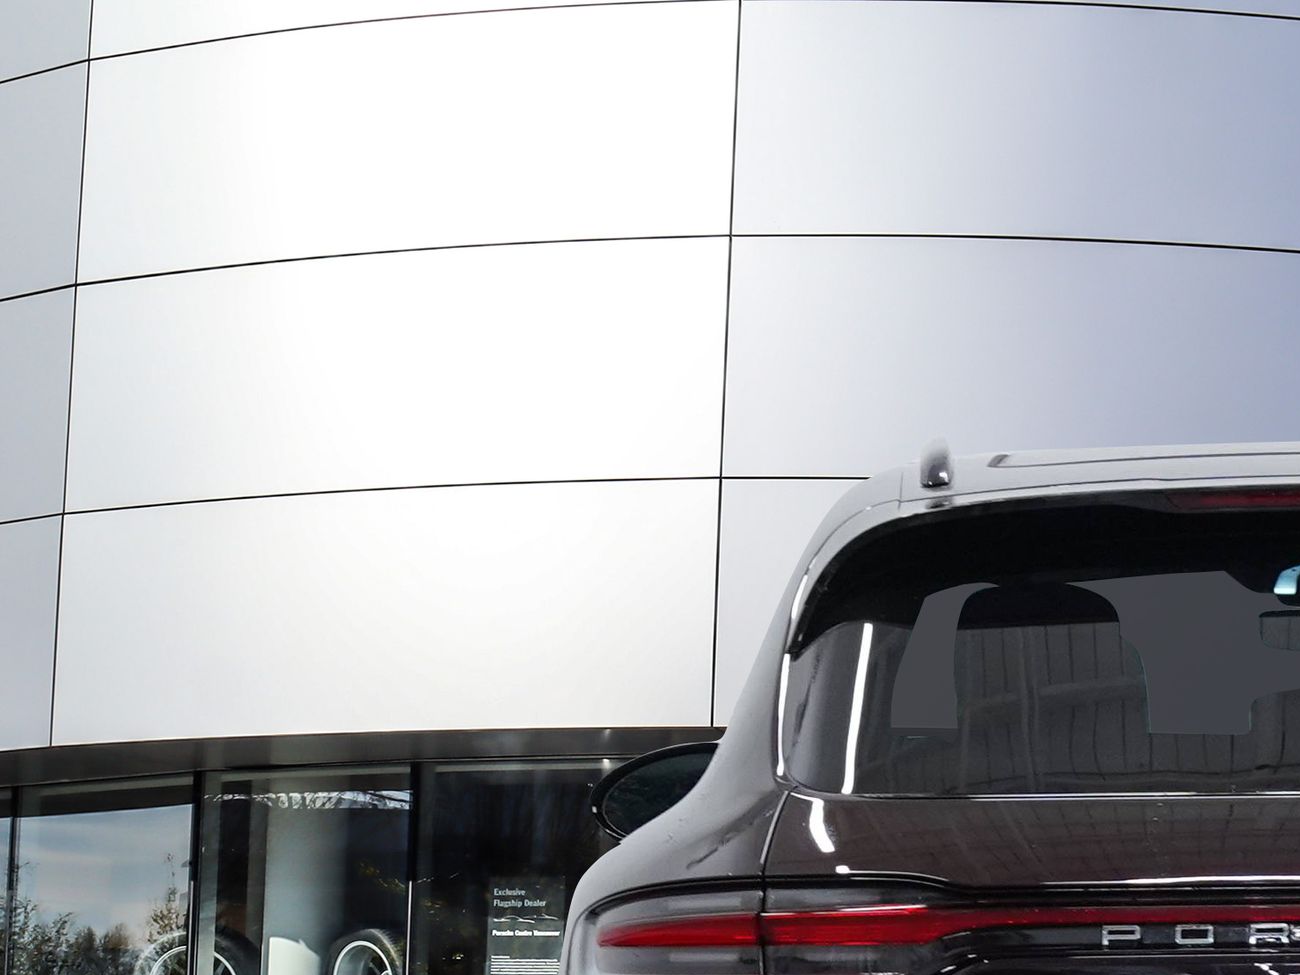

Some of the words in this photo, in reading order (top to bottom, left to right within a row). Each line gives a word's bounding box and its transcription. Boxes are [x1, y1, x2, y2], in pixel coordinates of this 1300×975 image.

[493, 888, 526, 896] Exclusive
[493, 899, 523, 908] Flagship
[524, 899, 546, 907] Dealer
